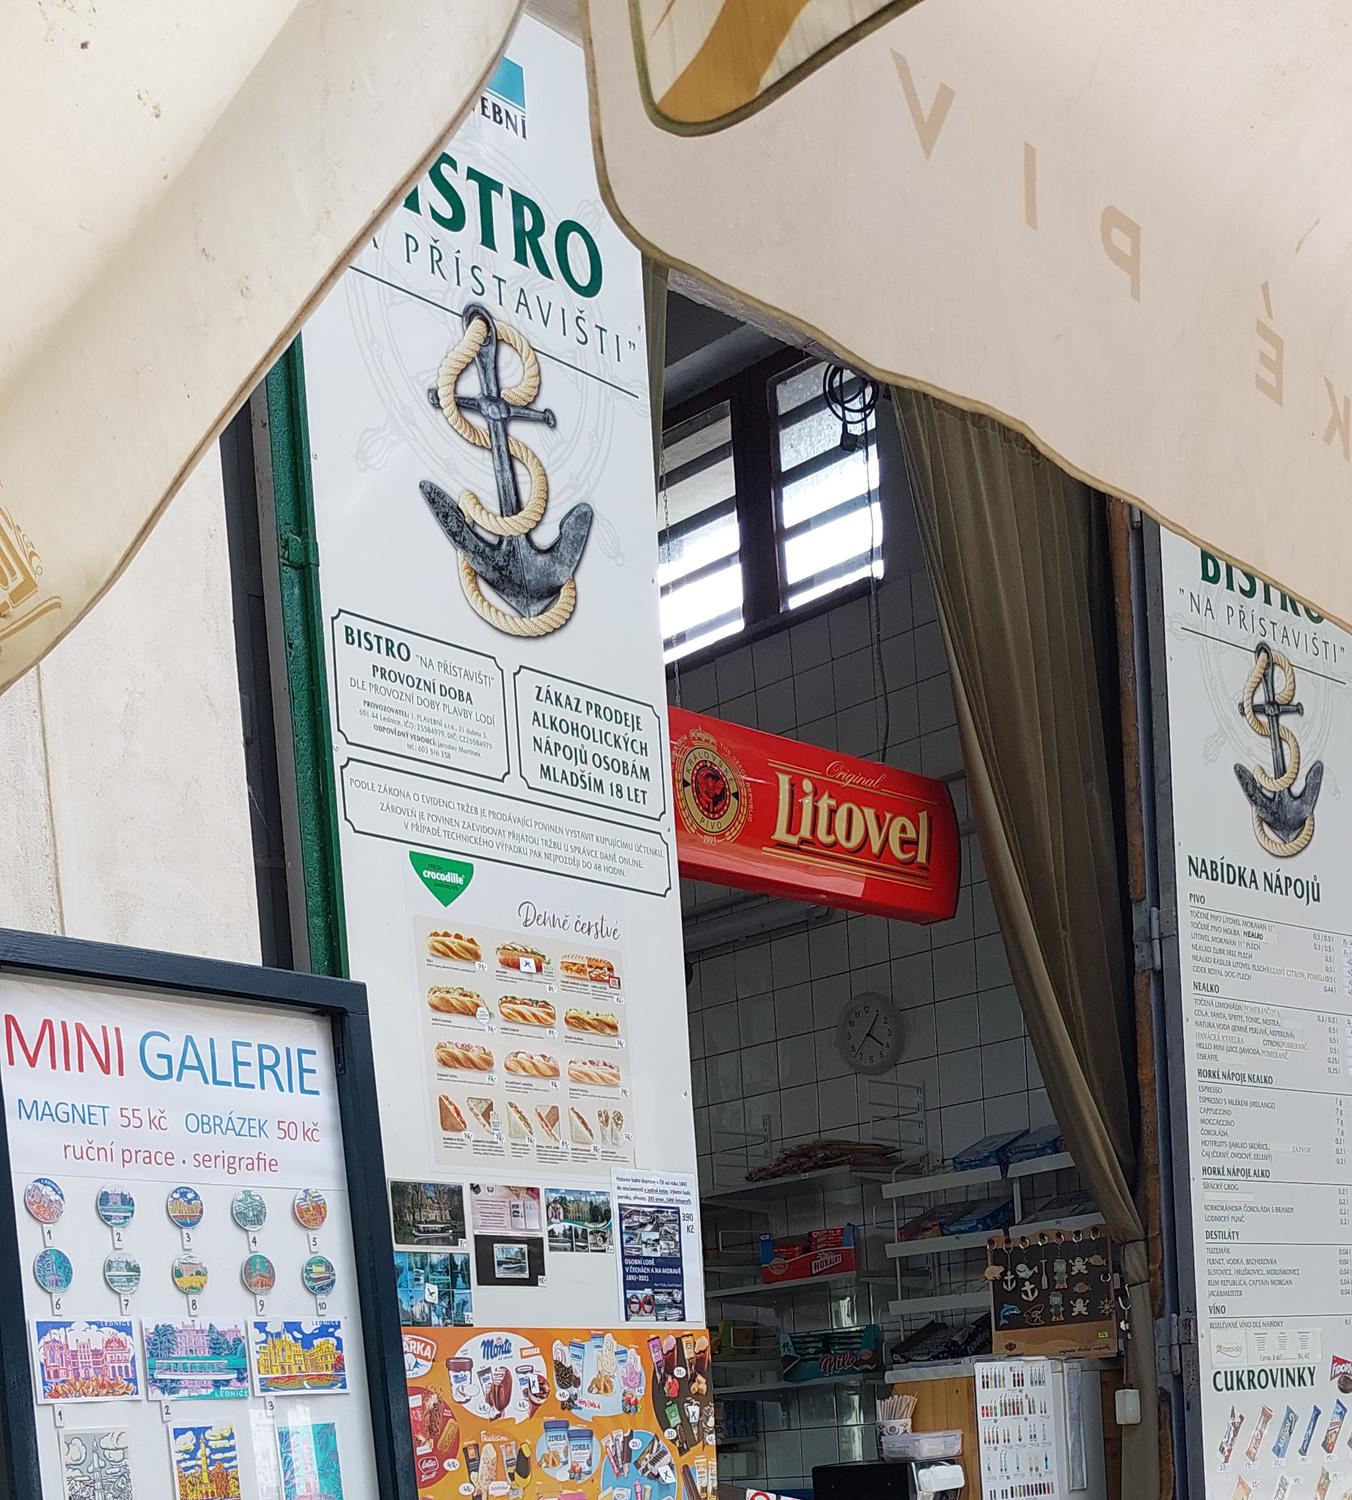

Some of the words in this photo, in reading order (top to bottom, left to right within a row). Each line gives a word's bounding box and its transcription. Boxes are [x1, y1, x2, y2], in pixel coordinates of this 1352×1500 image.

[344, 625, 412, 663] BISTRO
[372, 664, 437, 695] PROVOZNÍ
[439, 684, 474, 705] DOBA
[350, 677, 367, 692] DLE
[369, 682, 415, 705] PROVOZNÍ
[416, 695, 441, 711] DOBY
[442, 703, 473, 721] PLAVBY
[475, 710, 496, 727] LODÍ
[534, 684, 583, 714] ZÁKAZ
[585, 701, 643, 733] PRODEJE
[531, 710, 649, 758] ALKOHOLICKÝCH
[417, 745, 430, 755] 603
[533, 735, 588, 766] NÁPOJŮ
[592, 752, 651, 783] OSOBÁM
[539, 763, 605, 796] MLADŠÍM
[609, 781, 624, 800] 18
[626, 785, 648, 806] LET
[825, 760, 887, 791] Original
[349, 777, 376, 792] PODLE
[377, 784, 411, 801] ZÁKONA
[413, 792, 420, 801] O
[421, 793, 456, 811] EVIDENCI
[457, 800, 479, 816] TRŽEB
[480, 808, 487, 819] JE
[488, 810, 533, 829] PRODÁVAJÍCÍ
[534, 819, 564, 835] POVINEN
[564, 826, 594, 843] VYSTAVIT
[770, 771, 931, 867] Litovel
[380, 801, 418, 819] ZÁROVEŇ
[418, 811, 426, 822] JE
[427, 814, 460, 829] POVINEN
[507, 829, 540, 846] PŘIJATOU
[541, 837, 562, 852] TRŽBU
[570, 843, 599, 860] SPRÁVCE
[599, 851, 618, 863] DANĚ
[699, 815, 723, 830] PIVO
[403, 820, 410, 831] V
[411, 821, 442, 839] PŘÍPADĚ
[443, 829, 494, 849] TECHNICKÉHO
[495, 840, 529, 857] VÝPADKU
[529, 848, 543, 860] PAK
[581, 860, 593, 871] DO
[1187, 854, 1259, 892] NABÍDKA
[1263, 869, 1321, 907] NÁPOJŮ
[1189, 892, 1206, 905] PIVO
[517, 900, 571, 929] Denně
[573, 913, 622, 941] čerstvé
[1192, 980, 1220, 994] NEALKO
[3, 1013, 125, 1077] MINI
[138, 1030, 321, 1096] GALERIE
[1196, 1067, 1221, 1080] HORKÉ
[1221, 1069, 1246, 1084] NÁPOJE
[1247, 1073, 1274, 1085] NEALKO
[17, 1098, 110, 1127] MAGNET
[119, 1107, 144, 1129] 55
[148, 1107, 169, 1132] kč
[184, 1110, 270, 1140] OBRÁZEK
[276, 1120, 299, 1142] 50
[302, 1120, 321, 1144] kč
[63, 1140, 115, 1163] ruční
[121, 1144, 176, 1168] prace
[192, 1151, 279, 1176] serigrafie
[1201, 1165, 1226, 1177] HORKÉ
[1252, 1168, 1272, 1179] ALKO
[681, 1212, 694, 1223] 390
[46, 1229, 52, 1241] 1
[115, 1231, 123, 1243] 2
[184, 1232, 192, 1243] 3
[250, 1235, 258, 1247] 4
[311, 1236, 318, 1247] 5
[1205, 1230, 1240, 1241] DESTILÁTY
[54, 1298, 62, 1311] 6
[122, 1298, 130, 1311] 7
[190, 1298, 198, 1311] 8
[258, 1299, 265, 1313] 9
[317, 1300, 328, 1311] 10
[1208, 1302, 1226, 1315] VÍNO
[481, 1337, 513, 1361] Monte
[1212, 1366, 1317, 1393] CUKROVINKY
